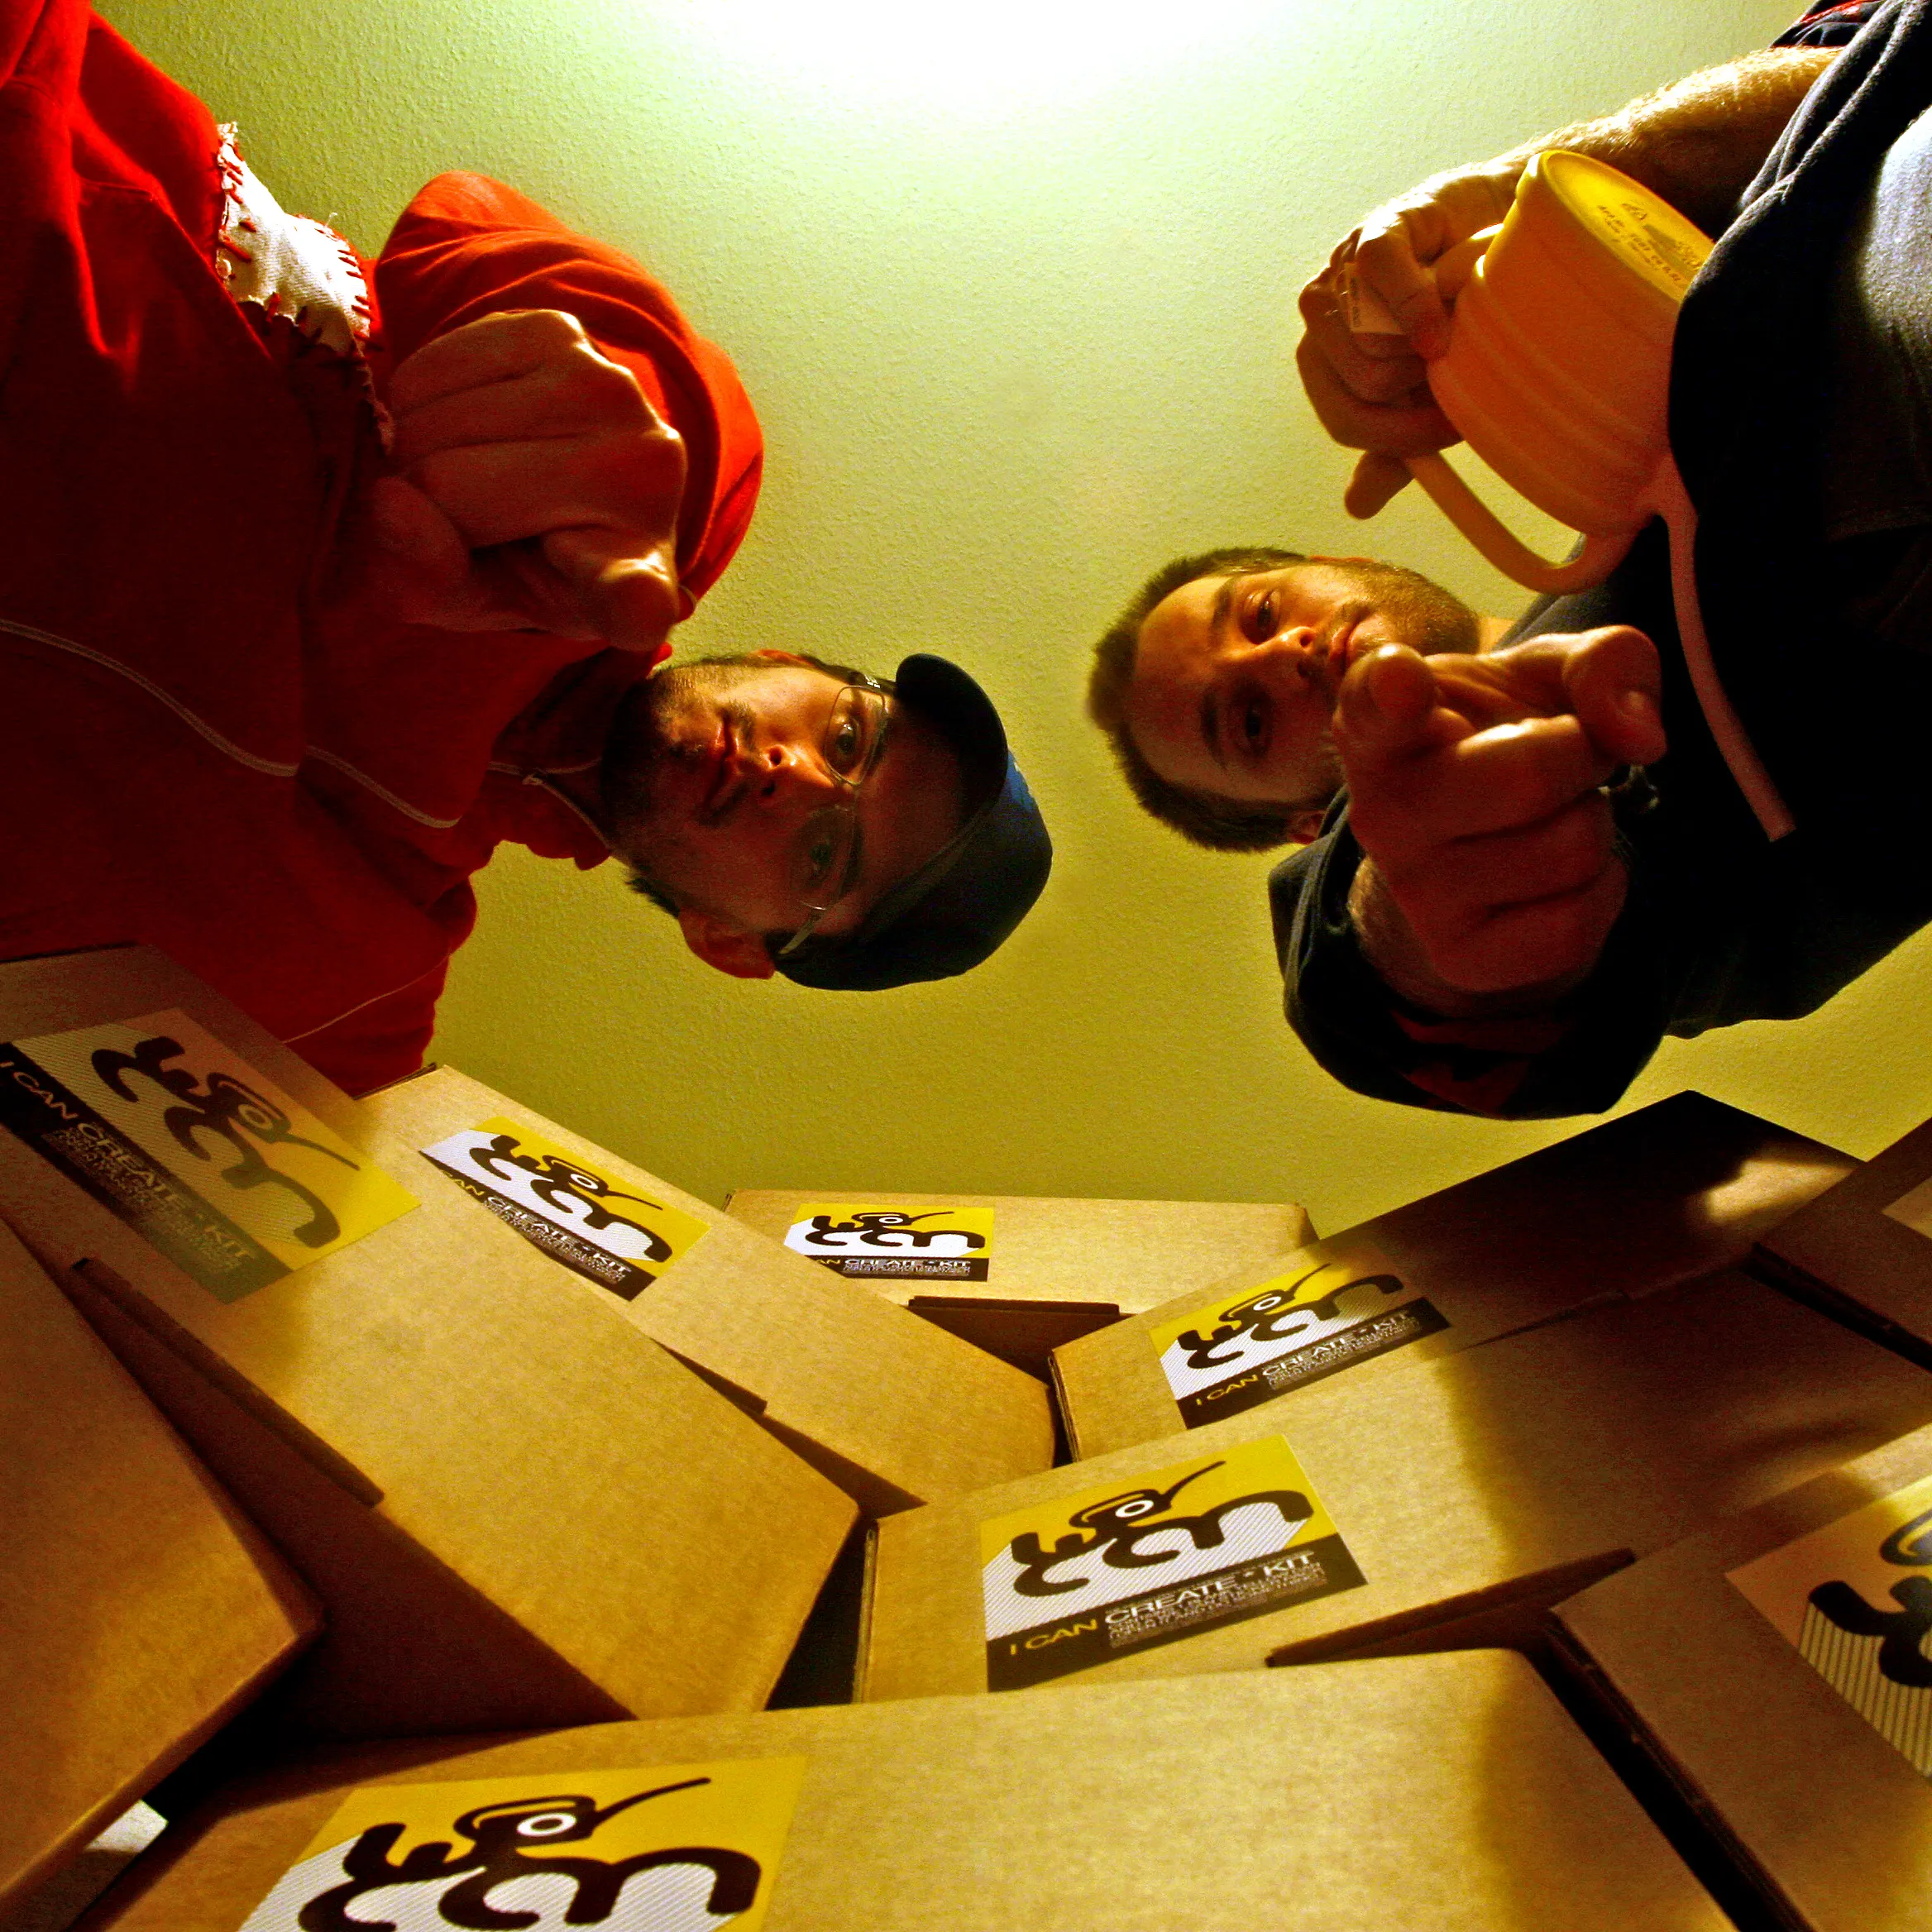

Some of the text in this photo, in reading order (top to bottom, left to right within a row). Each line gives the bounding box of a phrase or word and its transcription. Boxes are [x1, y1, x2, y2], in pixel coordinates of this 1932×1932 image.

[13, 1071, 79, 1120] CAN
[78, 1121, 188, 1209] CREATE
[593, 1252, 632, 1274] KIT
[1207, 1374, 1259, 1400] CAN
[1373, 1312, 1408, 1330] KIT
[1010, 1551, 1315, 1656] I CAN CREATE KIT
